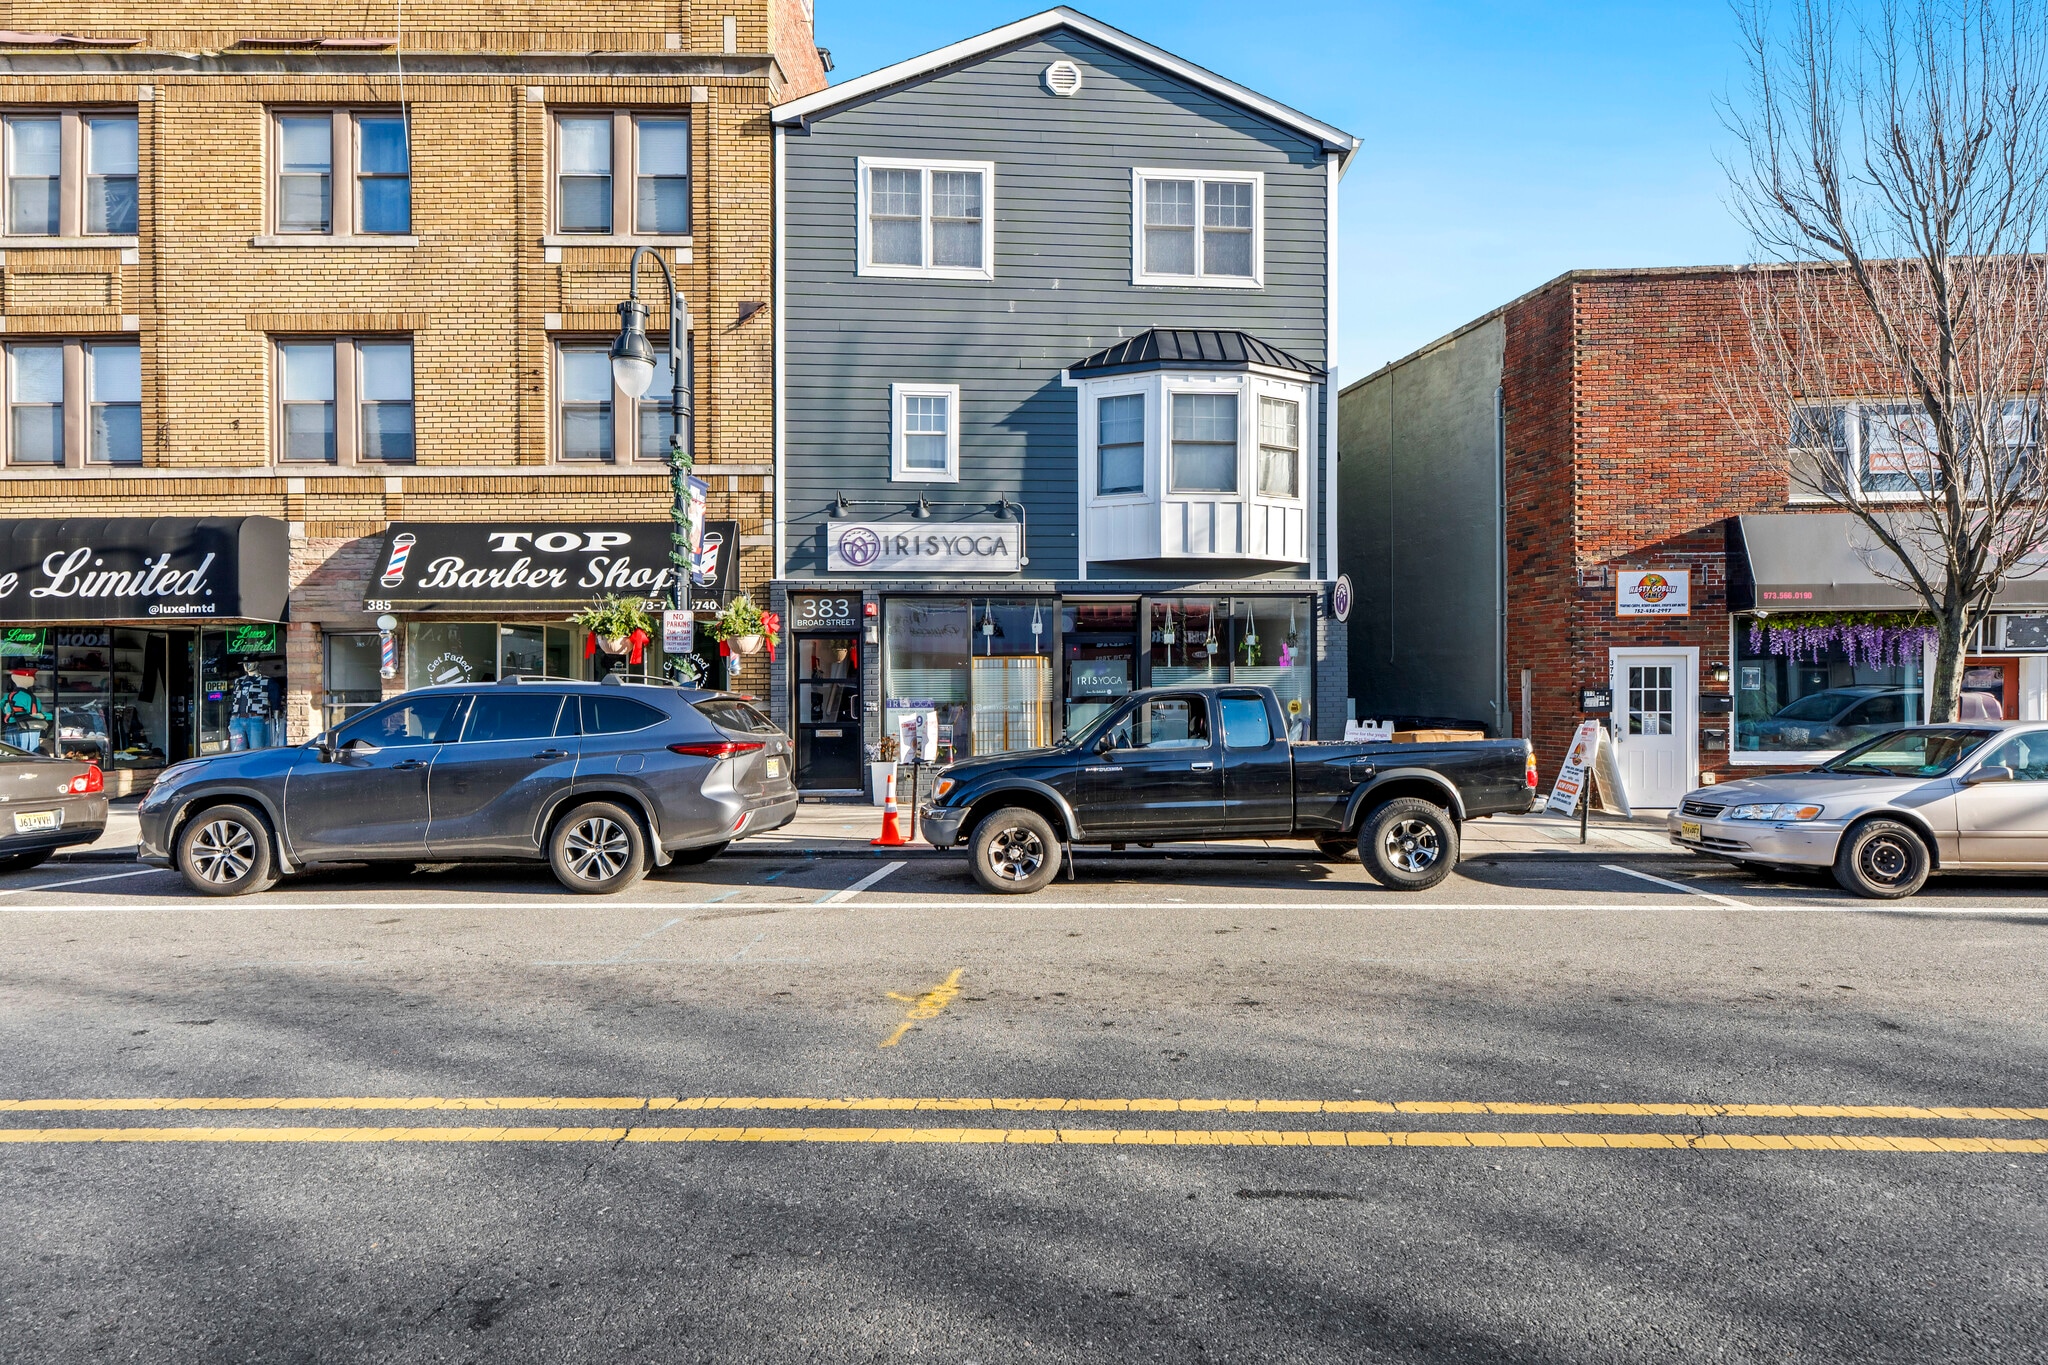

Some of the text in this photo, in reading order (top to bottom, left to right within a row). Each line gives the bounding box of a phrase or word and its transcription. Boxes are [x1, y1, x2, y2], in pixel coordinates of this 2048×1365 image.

[487, 531, 632, 552] TOP
[30, 546, 216, 598] Limited.
[418, 556, 568, 589] Barber
[578, 556, 675, 597] Shop
[1629, 585, 1678, 594] NASTY GOBLIN
[149, 603, 216, 615] @luxelmtd
[367, 600, 392, 610] 385
[803, 599, 850, 618] 383
[673, 613, 685, 621] NO
[666, 620, 691, 628] PARKING
[797, 619, 856, 627] BROAD STREET
[427, 652, 473, 673] Get Faded
[207, 682, 227, 691] OPEN
